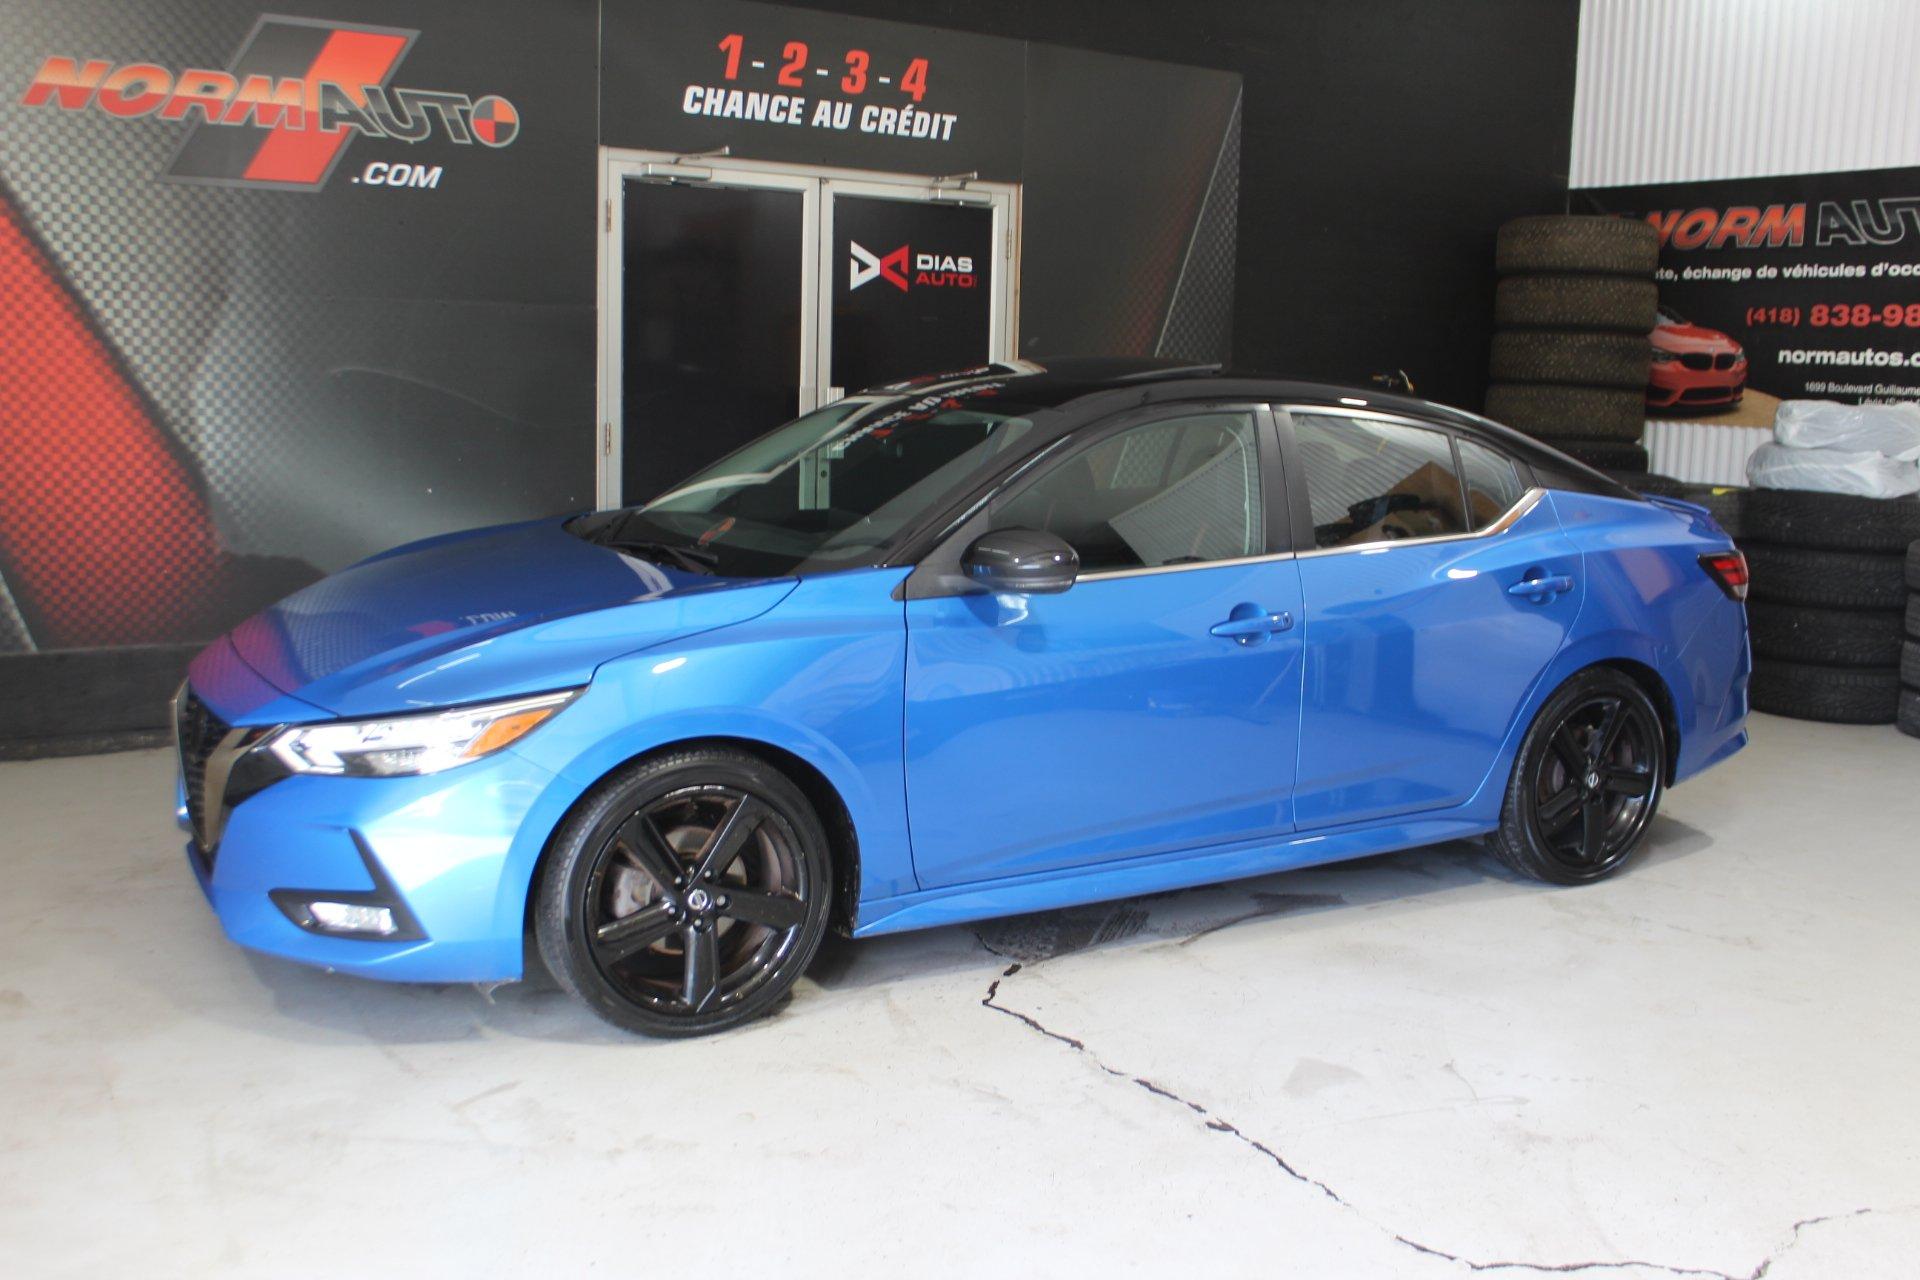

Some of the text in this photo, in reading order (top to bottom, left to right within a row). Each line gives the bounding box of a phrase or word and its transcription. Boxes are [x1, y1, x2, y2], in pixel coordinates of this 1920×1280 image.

[683, 85, 957, 141] CHANCE AU CRÉDIT
[351, 162, 443, 189] .COM
[916, 253, 973, 273] DIAS
[1682, 265, 1752, 282] échange
[1756, 264, 1778, 280] de
[1782, 262, 1867, 278] véhicules
[916, 272, 973, 288] AUTO
[1746, 306, 1800, 327] (418)
